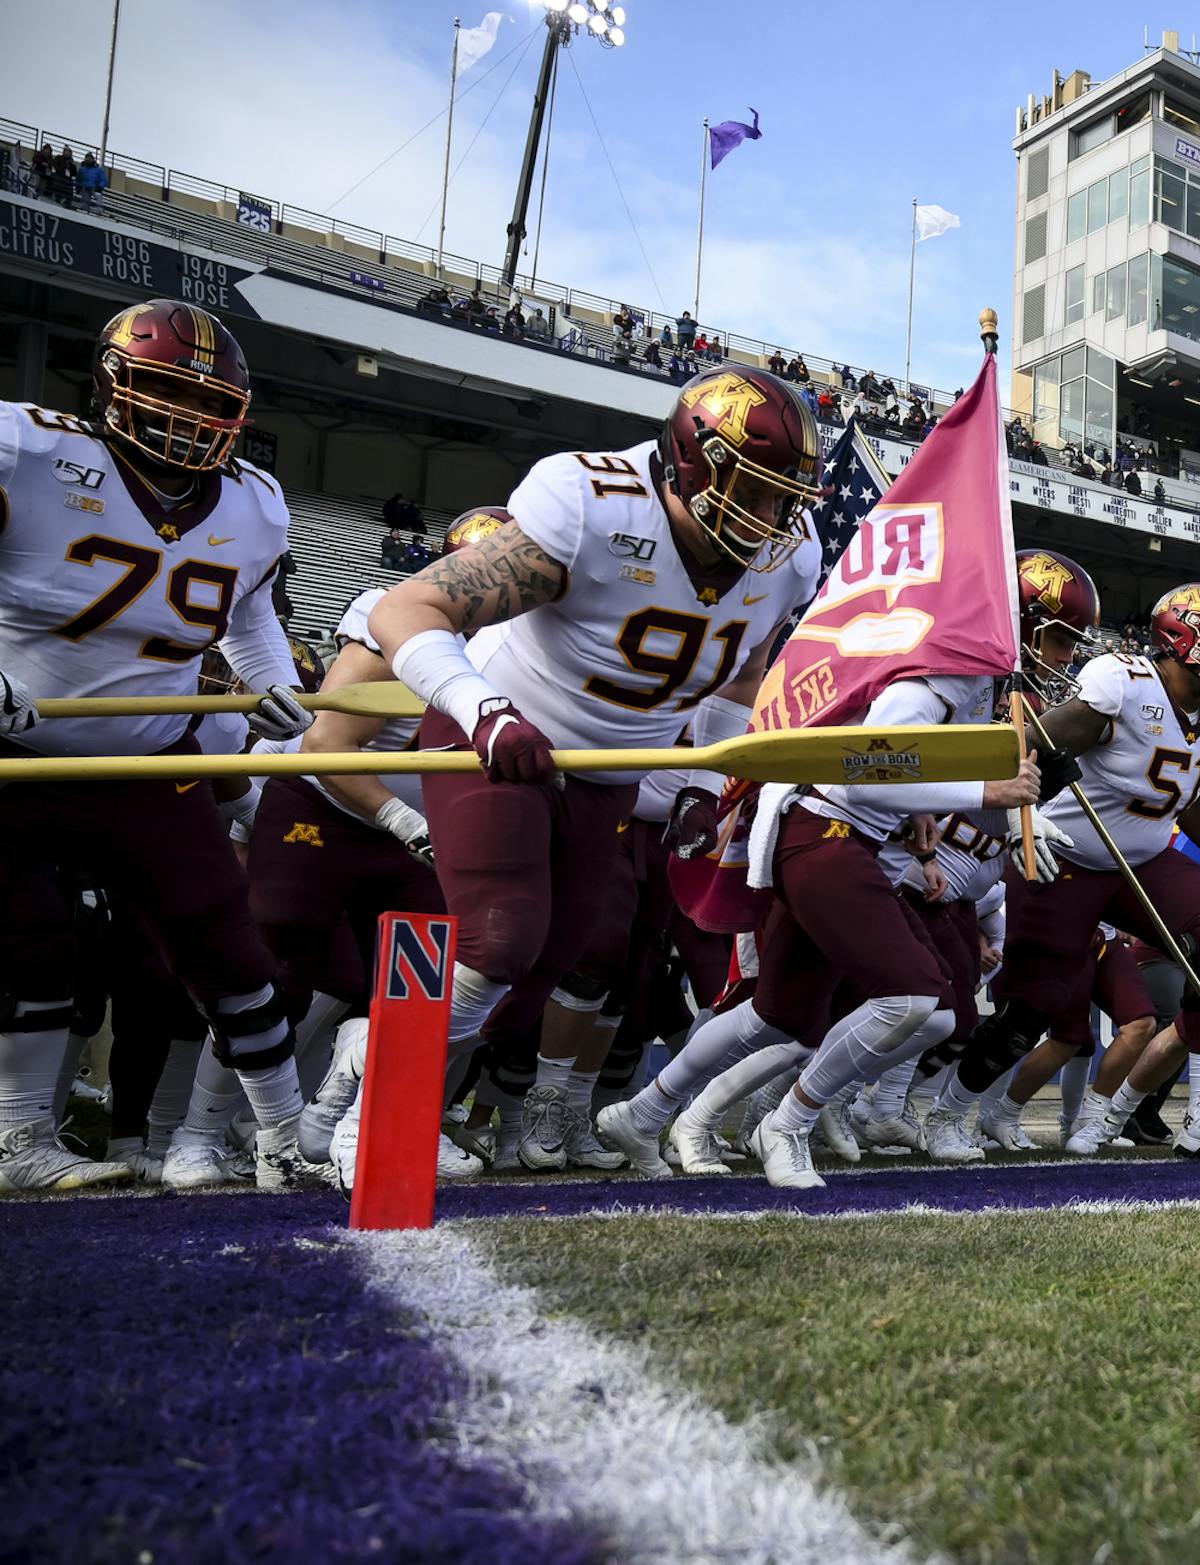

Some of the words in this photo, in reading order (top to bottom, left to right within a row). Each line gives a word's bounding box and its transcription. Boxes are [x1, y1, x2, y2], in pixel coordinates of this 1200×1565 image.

[10, 204, 60, 239] 1997
[239, 206, 270, 232] 225
[0, 224, 74, 266] CITRUS
[104, 231, 150, 264] 1996
[103, 254, 153, 287] ROSE
[183, 254, 227, 285] 1949
[181, 276, 229, 309] ROSE
[190, 359, 214, 374] ROW
[1018, 464, 1067, 481] AMERICANS
[1033, 486, 1055, 500] MYERS
[1111, 497, 1128, 508] JAMES
[1103, 503, 1136, 520] ANDREOTTI
[1148, 513, 1172, 527] COLLIER
[608, 532, 657, 560] 150
[51, 533, 240, 664] 79
[582, 606, 750, 713] 91
[1140, 704, 1164, 720] 150
[845, 756, 869, 767] ROW
[888, 754, 917, 765] BOAT
[386, 919, 450, 1000] N
